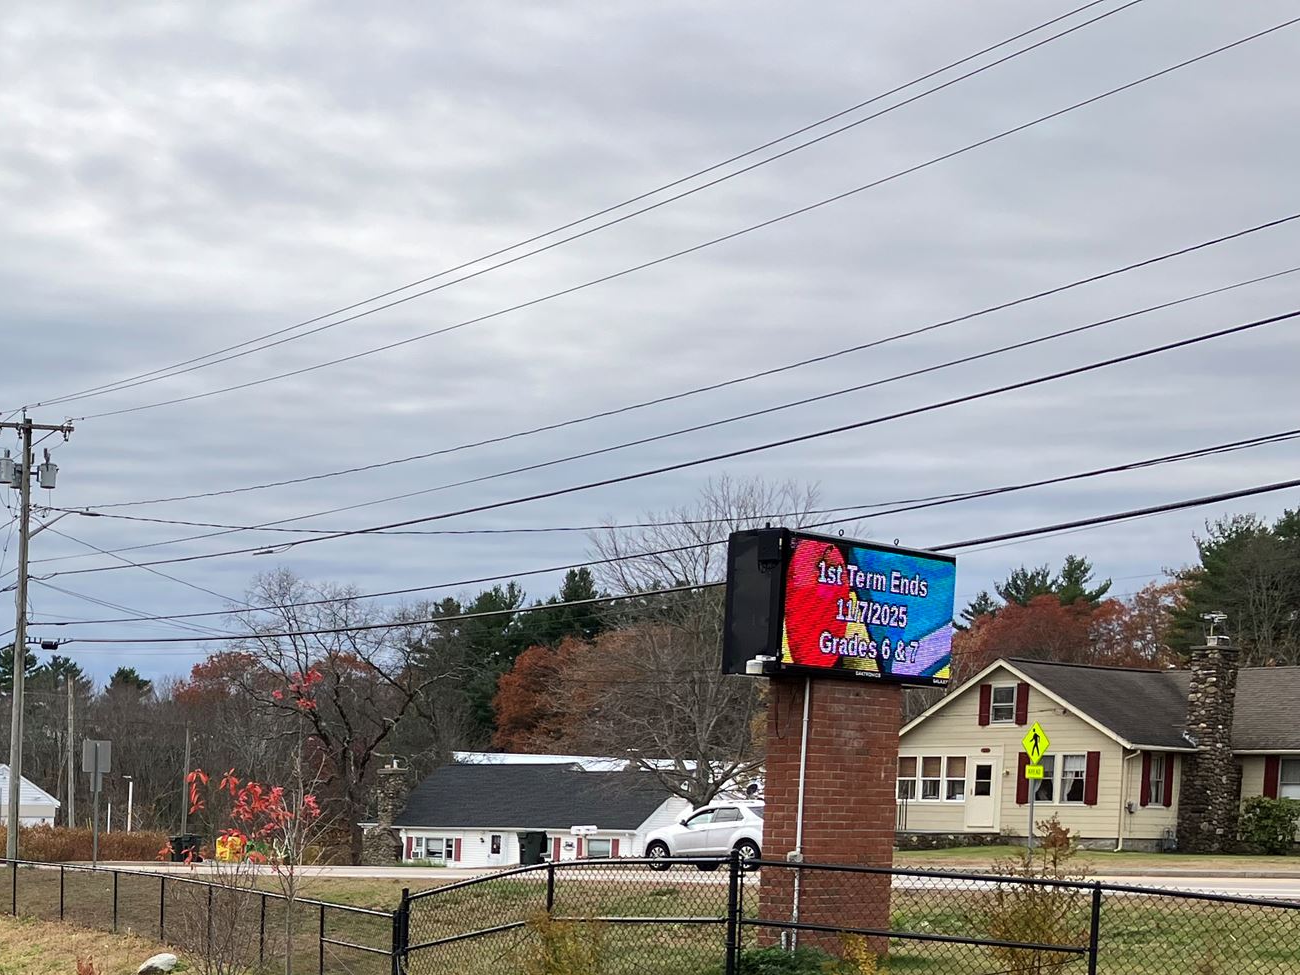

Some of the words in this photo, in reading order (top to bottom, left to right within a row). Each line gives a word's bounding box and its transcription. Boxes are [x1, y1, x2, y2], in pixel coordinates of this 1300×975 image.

[817, 560, 843, 585] 1st
[846, 565, 886, 592] Term
[890, 571, 928, 598] Ends
[835, 598, 908, 628] 11/7/2025
[819, 631, 878, 659] Grades
[881, 640, 890, 659] 6
[894, 643, 906, 662] &
[910, 642, 920, 664] 7
